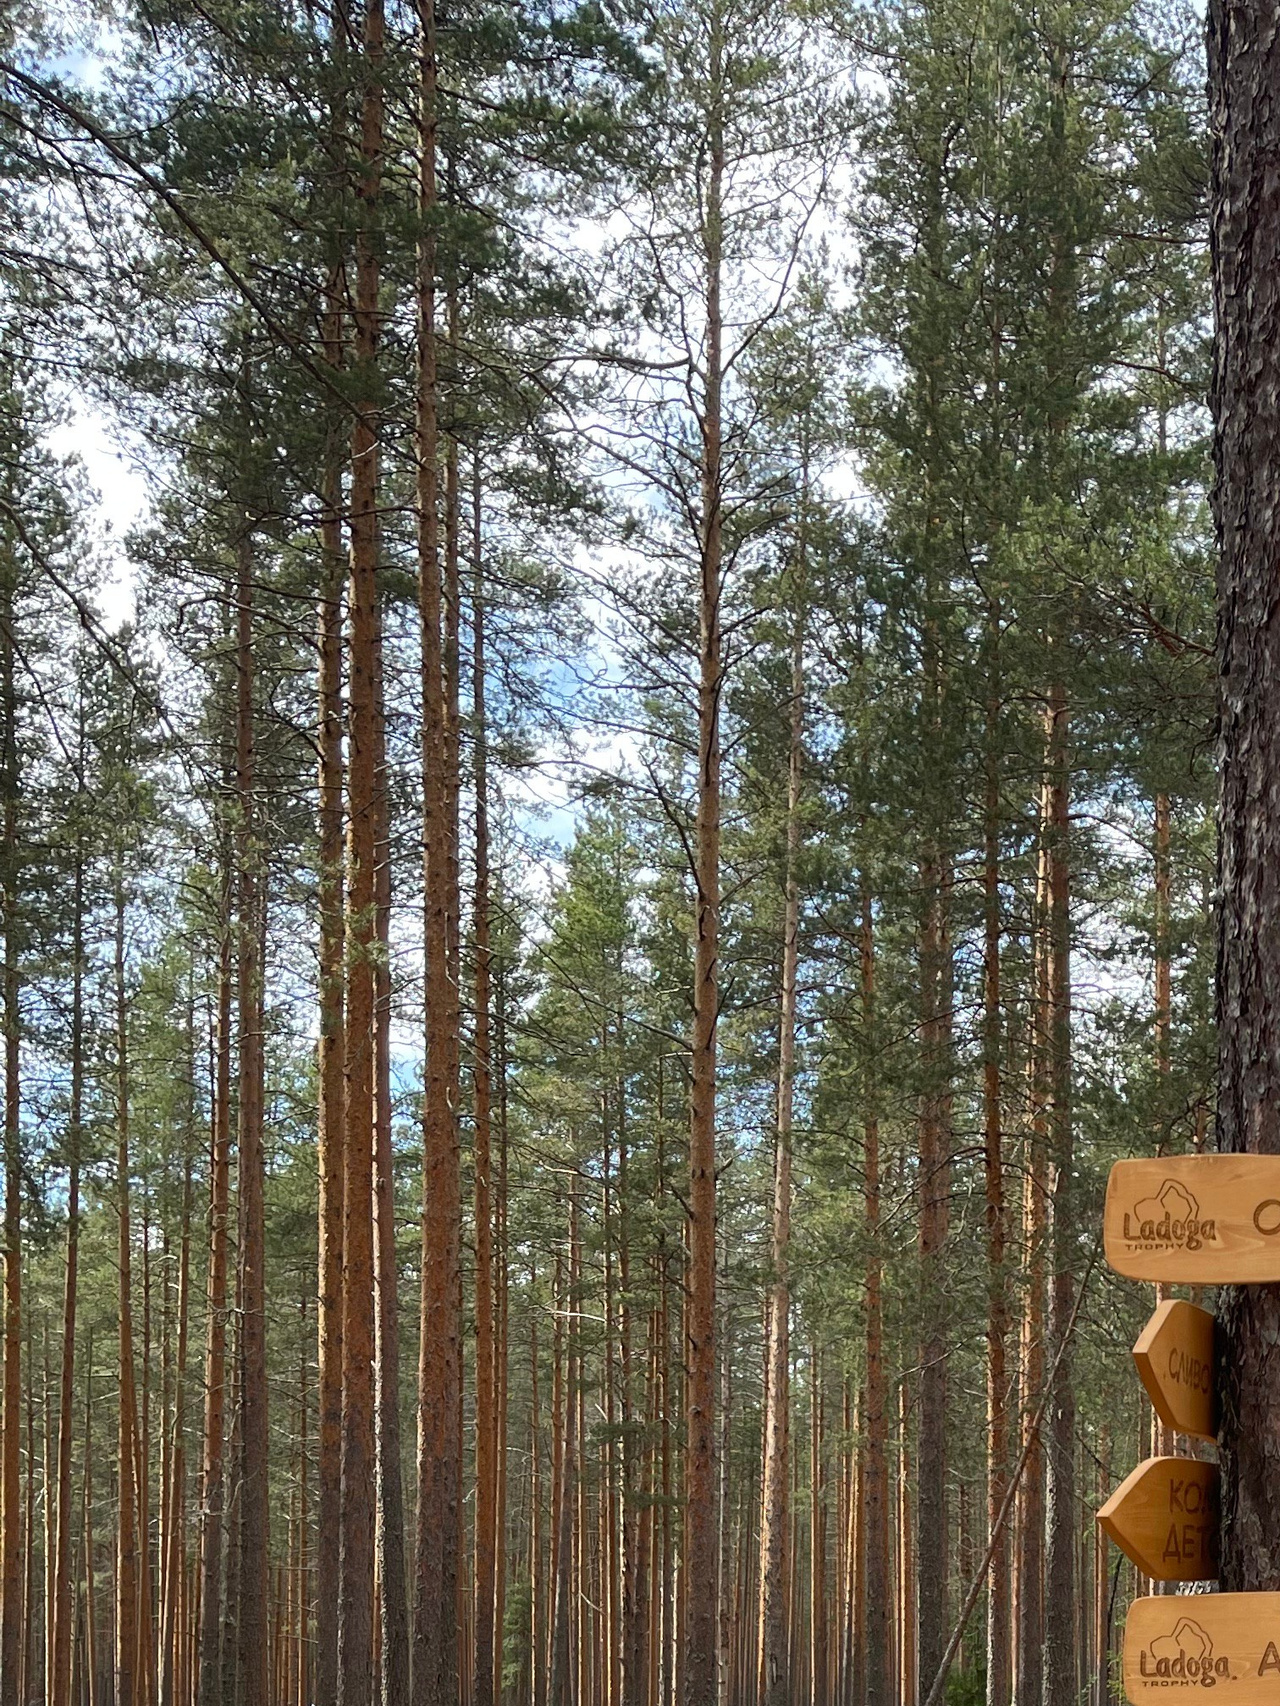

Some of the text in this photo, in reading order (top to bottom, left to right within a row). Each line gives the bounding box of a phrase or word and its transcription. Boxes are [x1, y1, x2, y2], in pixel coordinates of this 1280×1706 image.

[1123, 1211, 1217, 1251] Ladoga
[1125, 1243, 1184, 1251] TROPHY
[1140, 1648, 1230, 1688] Ladoga
